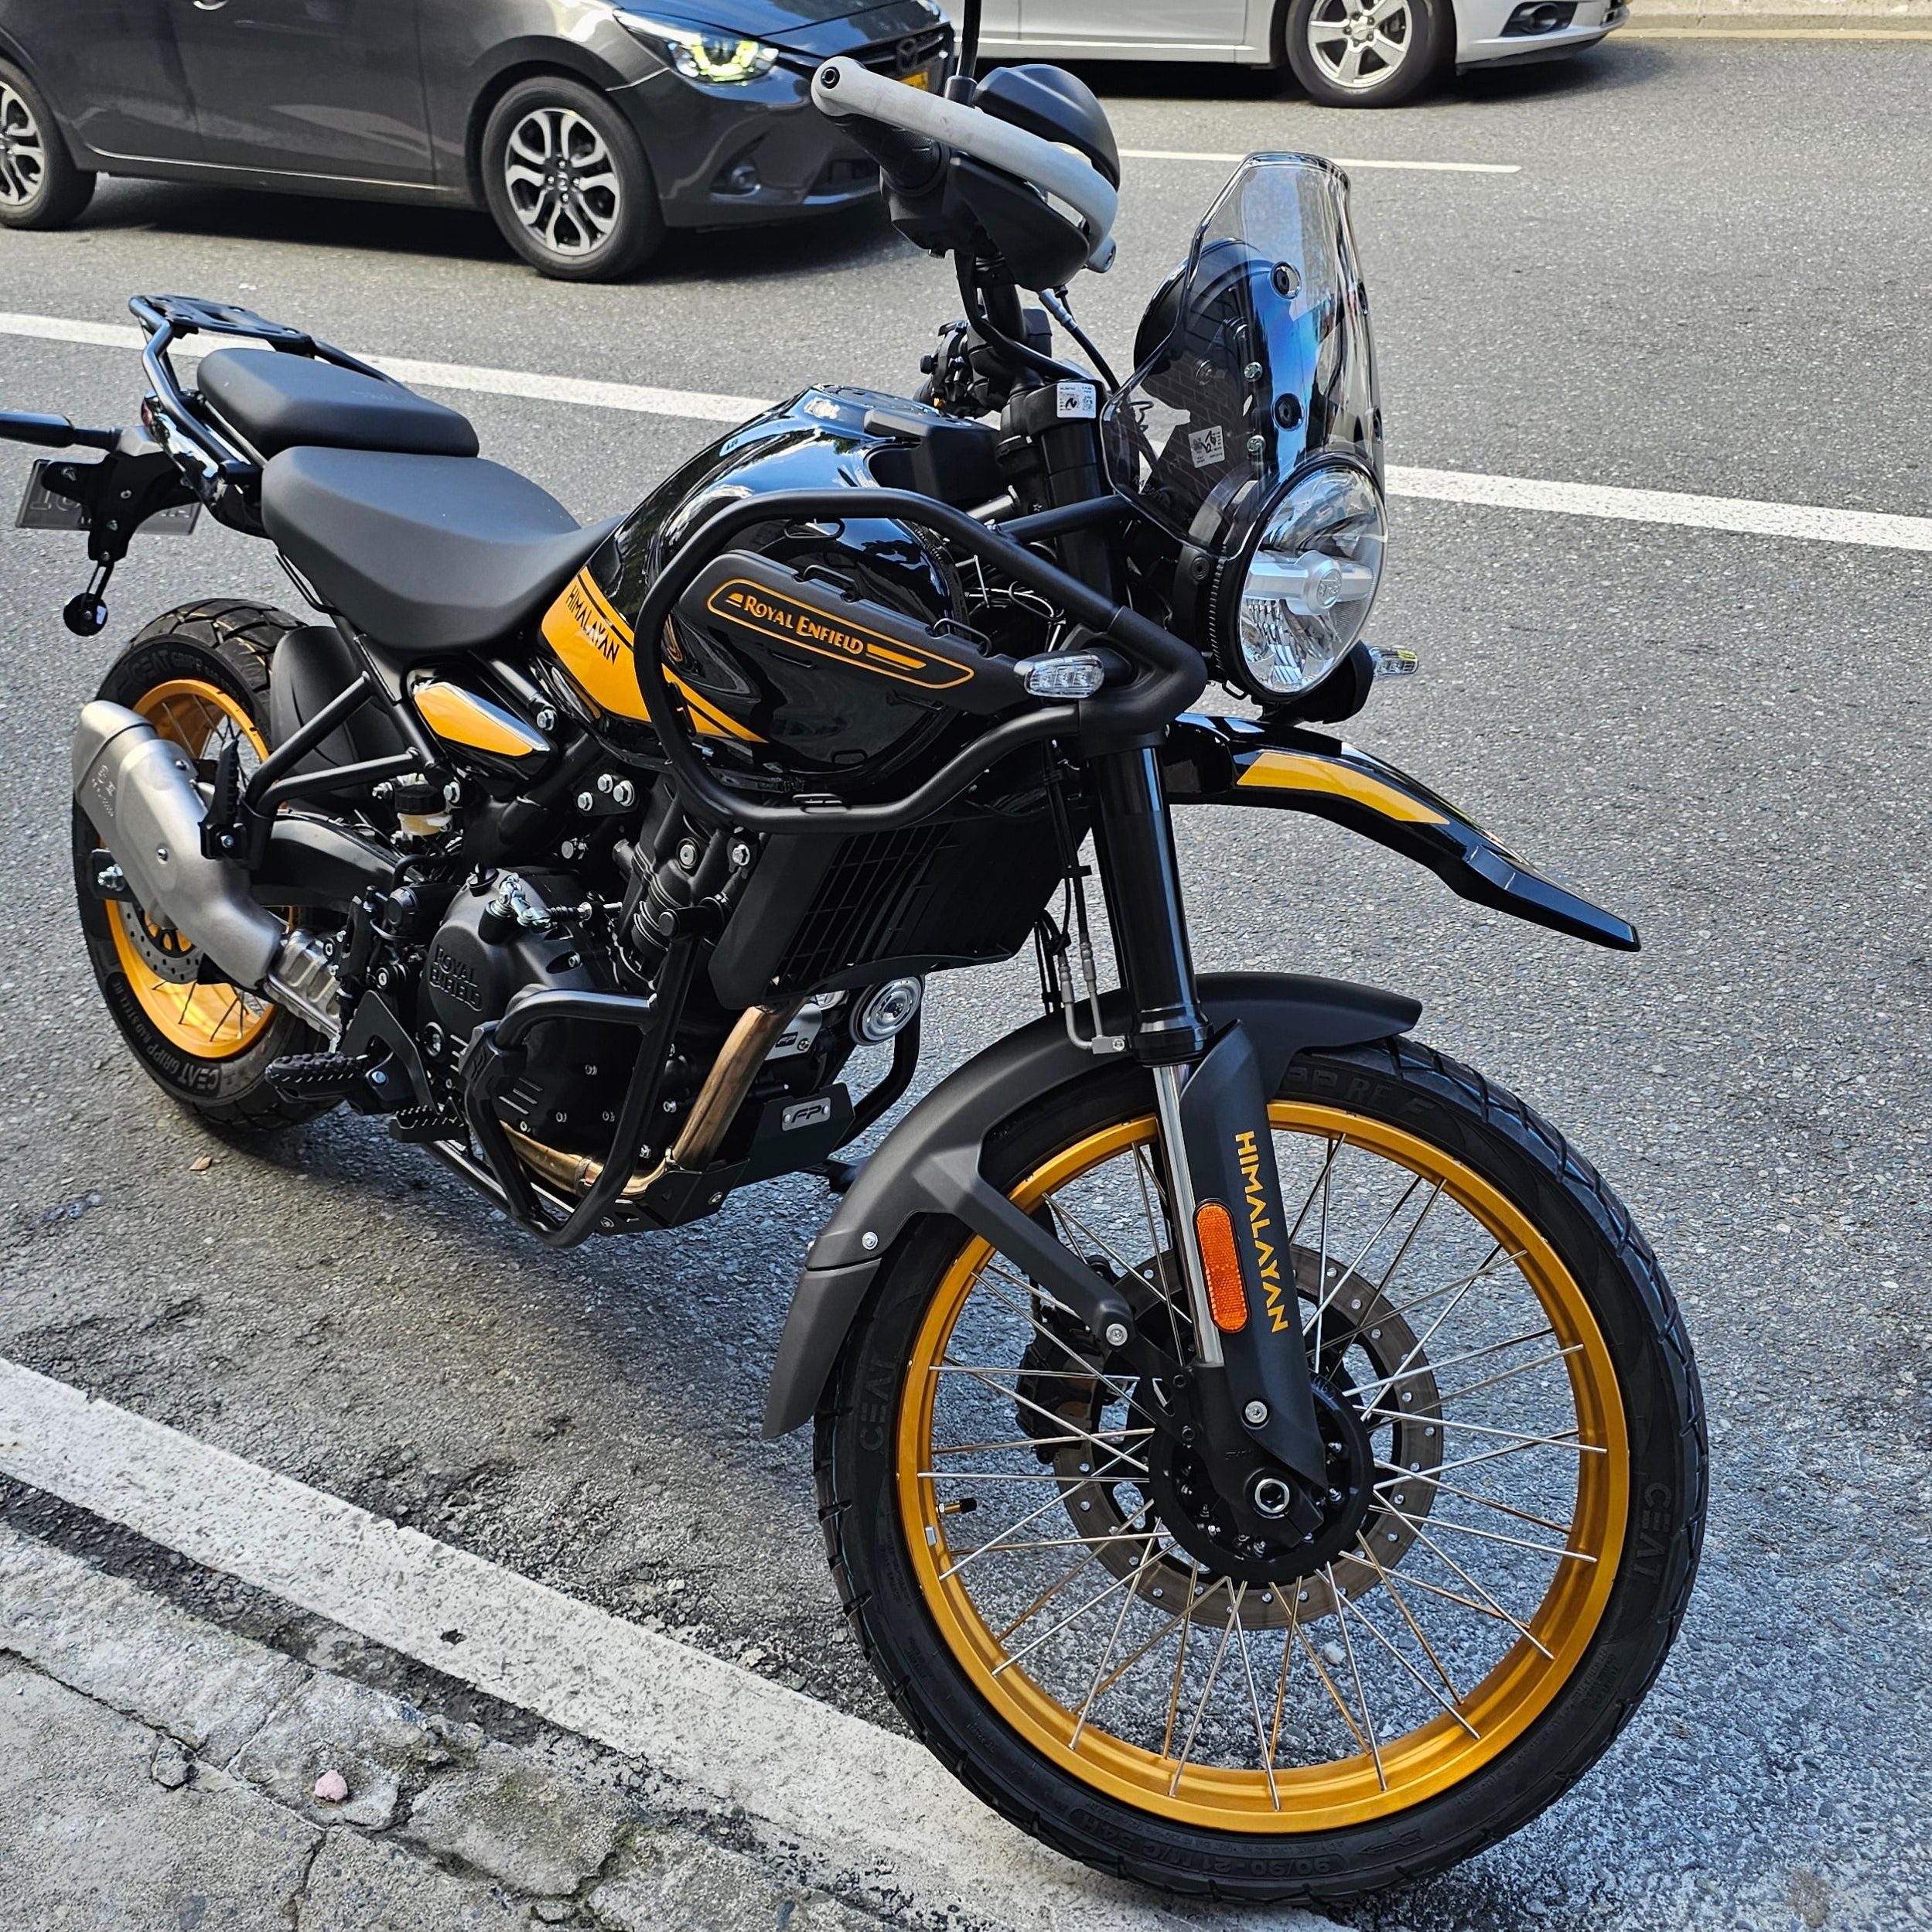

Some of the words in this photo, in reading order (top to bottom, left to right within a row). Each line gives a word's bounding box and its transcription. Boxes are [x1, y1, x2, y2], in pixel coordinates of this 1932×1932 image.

[565, 585, 620, 666] HIMALAYAN
[743, 595, 794, 629] ROYAL
[795, 615, 865, 654] ENFIELD
[429, 964, 483, 1012] ENFIELD
[435, 944, 478, 988] ROYAL
[147, 1044, 180, 1074] GRIPP
[176, 1062, 220, 1091] CEAT
[790, 1104, 822, 1124] FP
[1235, 1131, 1289, 1333] HIMALAYAN
[859, 1356, 897, 1452] CEAT
[1633, 1482, 1672, 1585] CEAT
